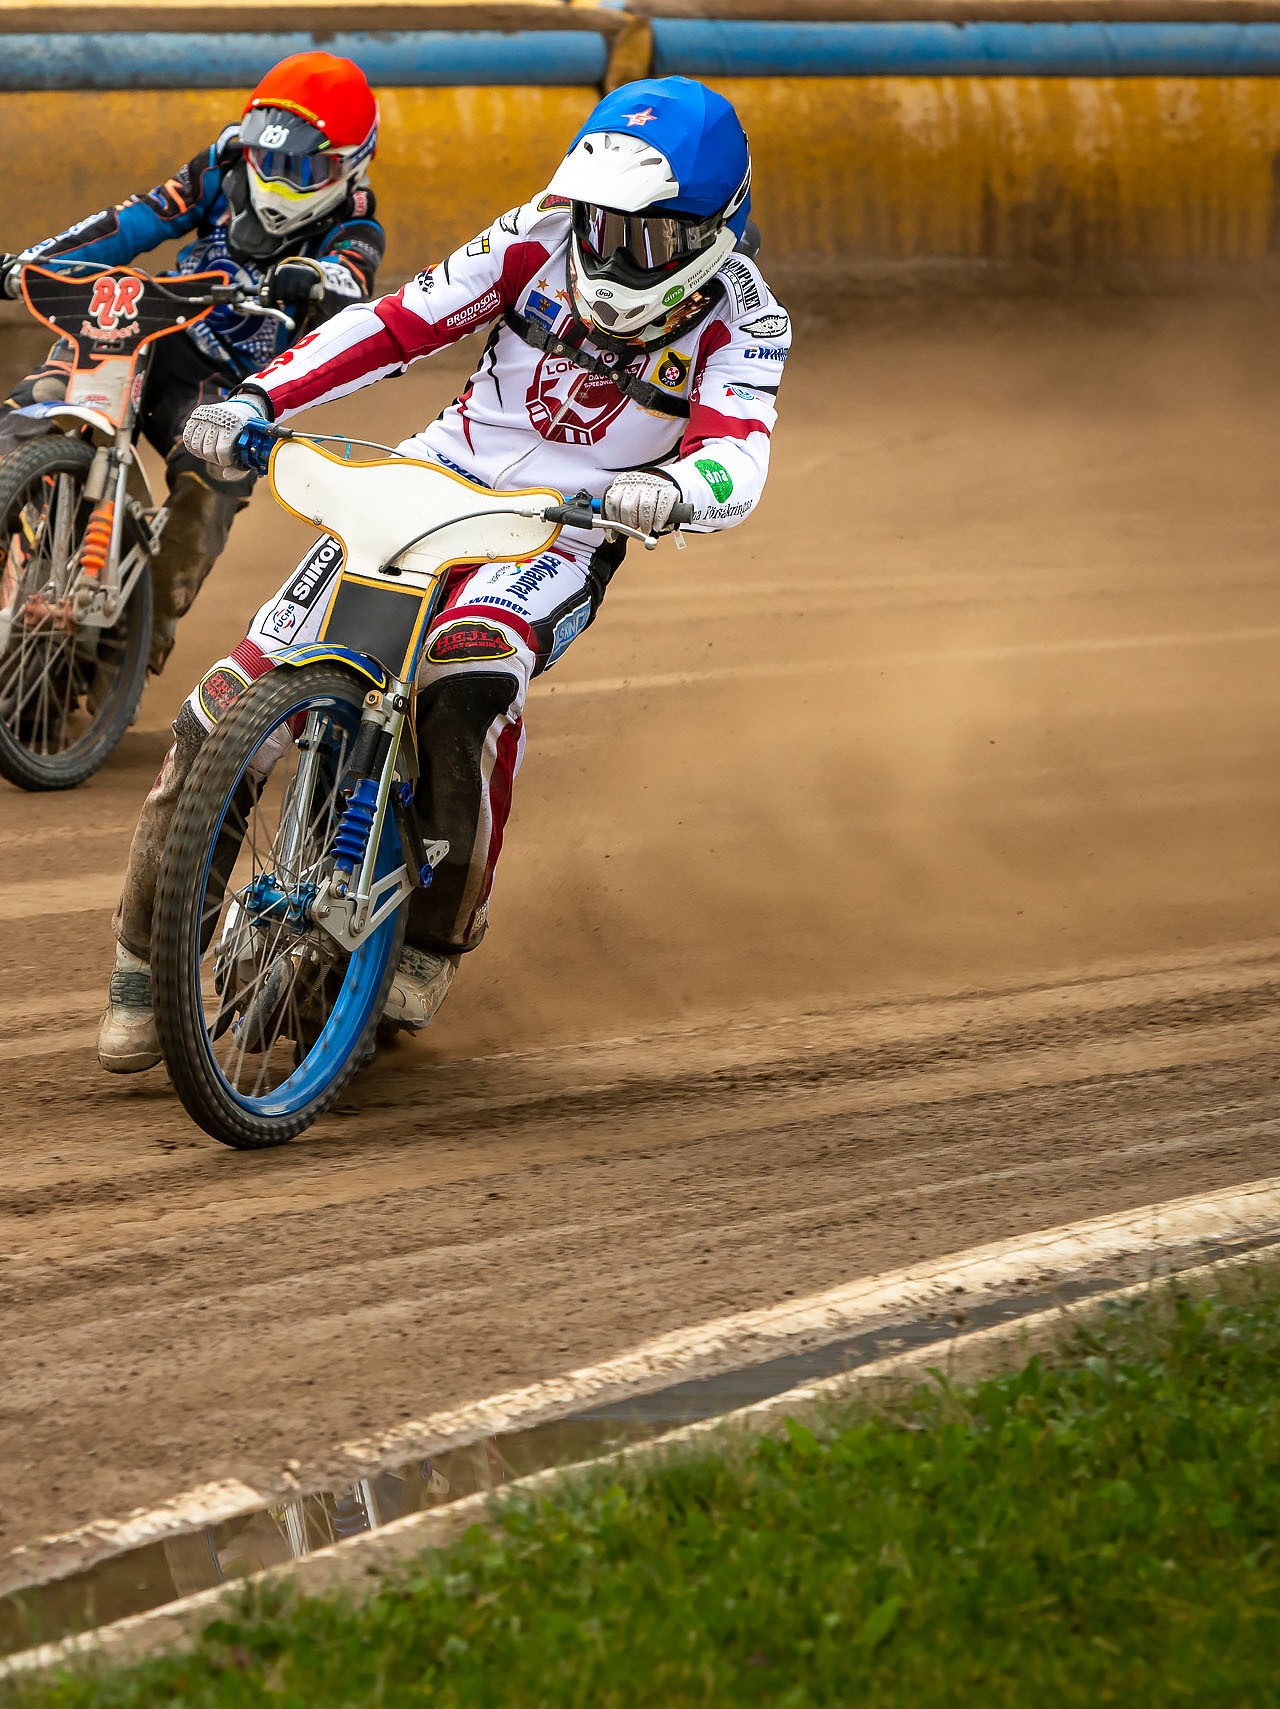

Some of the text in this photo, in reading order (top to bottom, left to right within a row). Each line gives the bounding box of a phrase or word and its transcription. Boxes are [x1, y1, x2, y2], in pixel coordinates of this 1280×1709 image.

[446, 290, 497, 327] BRODDSON
[80, 320, 140, 342] Transport
[583, 380, 615, 388] SPEEDWA
[661, 377, 676, 386] PZM
[292, 538, 342, 600] Silkol
[467, 595, 531, 616] winner
[273, 603, 295, 633] FUCHS
